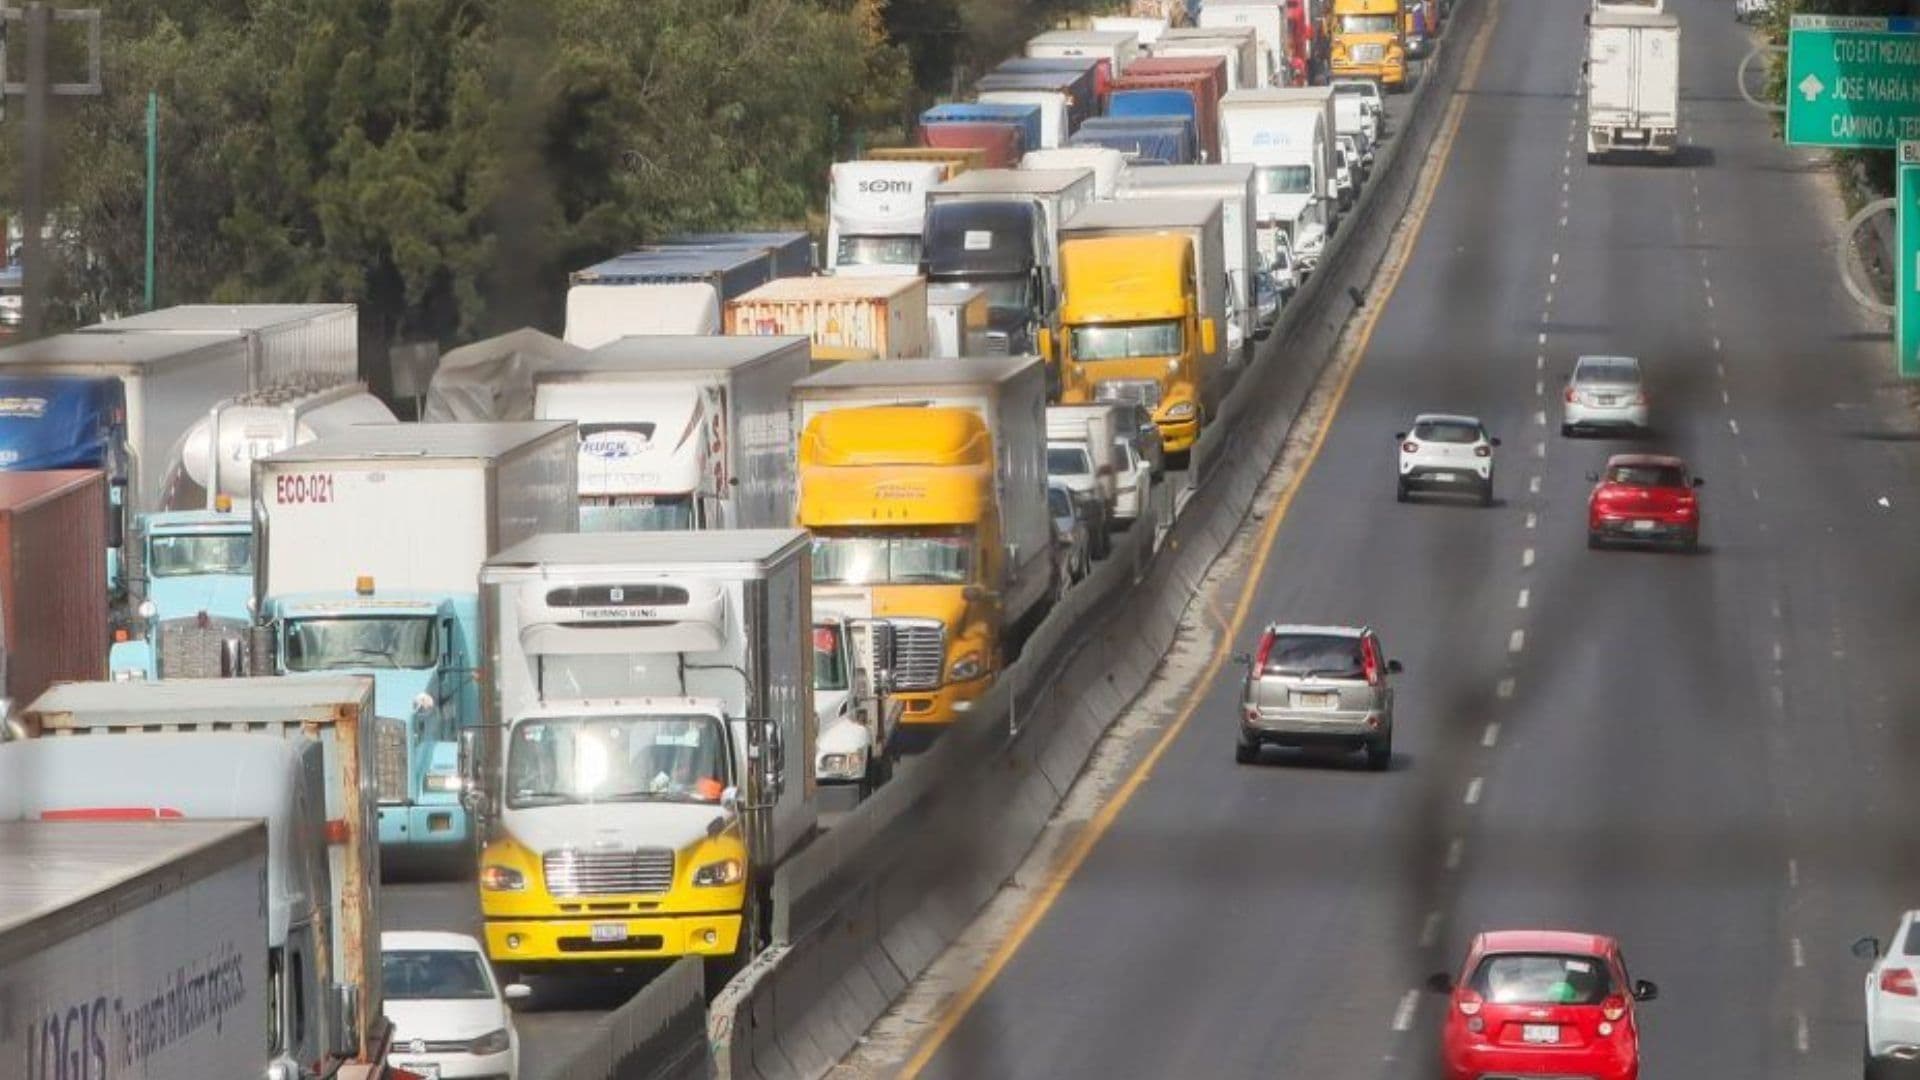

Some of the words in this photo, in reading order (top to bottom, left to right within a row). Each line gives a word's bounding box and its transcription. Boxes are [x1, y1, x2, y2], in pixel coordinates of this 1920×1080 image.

[1833, 39, 1856, 62] CTO
[1832, 73, 1864, 99] JOSÉ
[1867, 76, 1908, 103] MARÍA
[1831, 113, 1883, 139] CAMINO
[1885, 116, 1895, 139] A
[277, 474, 334, 504] ECO-021
[580, 609, 627, 618] THERMO
[630, 608, 657, 617] KING
